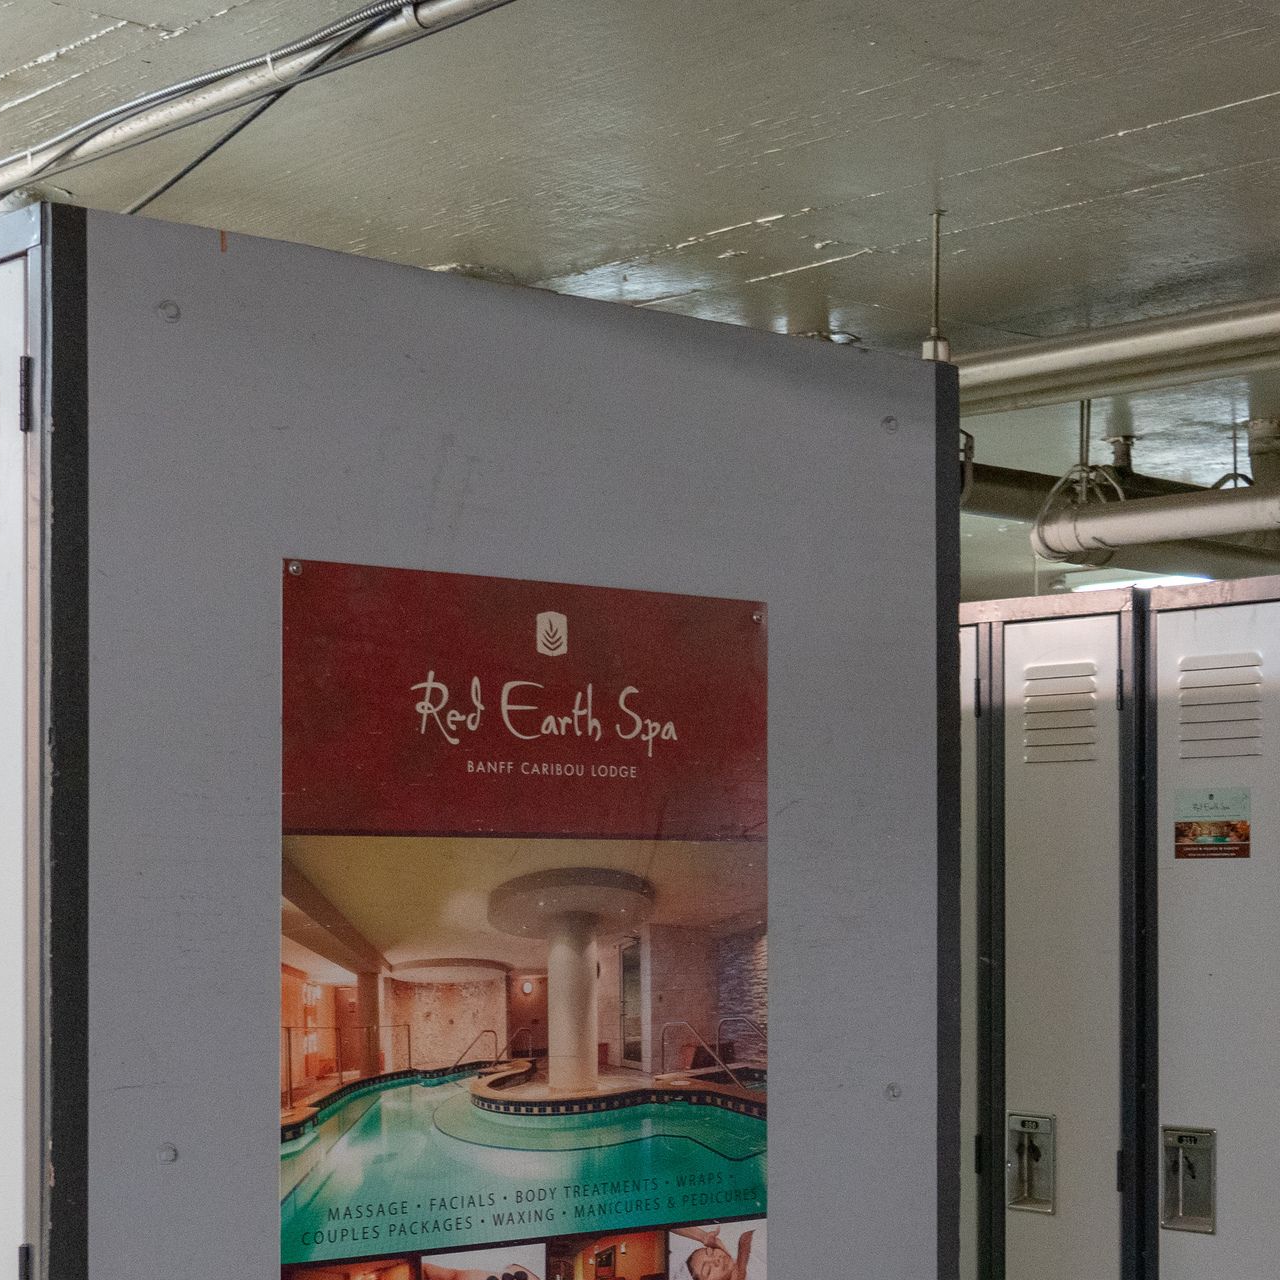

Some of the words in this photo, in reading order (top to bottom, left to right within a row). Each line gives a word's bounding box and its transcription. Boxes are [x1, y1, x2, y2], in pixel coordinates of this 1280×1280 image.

[410, 670, 485, 745] Red
[500, 680, 602, 742] Earth
[615, 685, 678, 758] Spa
[467, 760, 514, 775] BANFF
[520, 762, 585, 777] CARIBOU
[591, 764, 637, 779] LODGE
[301, 1225, 380, 1246] COUPLES
[388, 1216, 473, 1237] PACKAGES
[492, 1208, 556, 1227] WAXING
[574, 1198, 660, 1219] MANICURES
[668, 1196, 677, 1209] &
[682, 1186, 758, 1208] PEDICURES
[327, 1200, 409, 1222] MASSAGE
[430, 1192, 496, 1212] FACIALS
[515, 1186, 557, 1204] BODY
[564, 1177, 659, 1200] TREATMENTS
[676, 1174, 722, 1188] WRAPS
